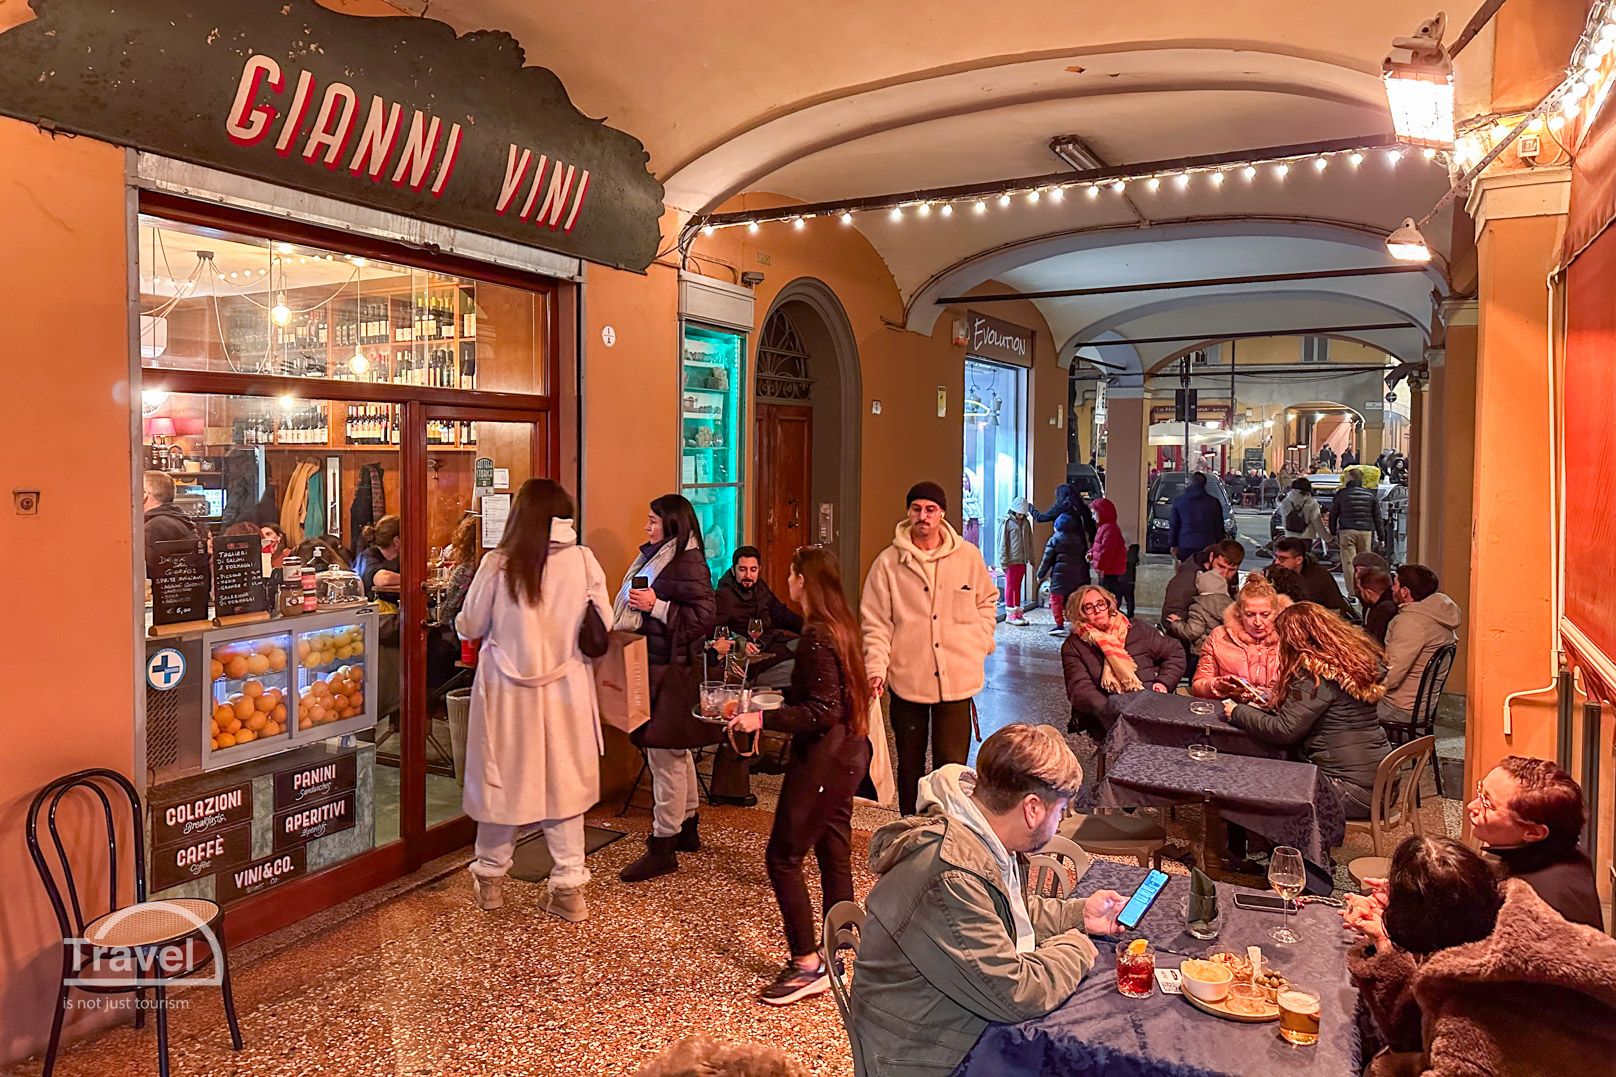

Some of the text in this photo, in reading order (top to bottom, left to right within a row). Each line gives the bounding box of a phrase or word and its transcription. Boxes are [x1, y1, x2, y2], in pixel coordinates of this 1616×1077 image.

[226, 54, 590, 235] GIANNI VINI
[293, 764, 336, 790] PANINI
[165, 789, 242, 826] COLAZIONI
[285, 800, 345, 833] APERITIVI
[176, 834, 224, 867] CAFFÈ
[234, 856, 295, 889] VINI&CO.
